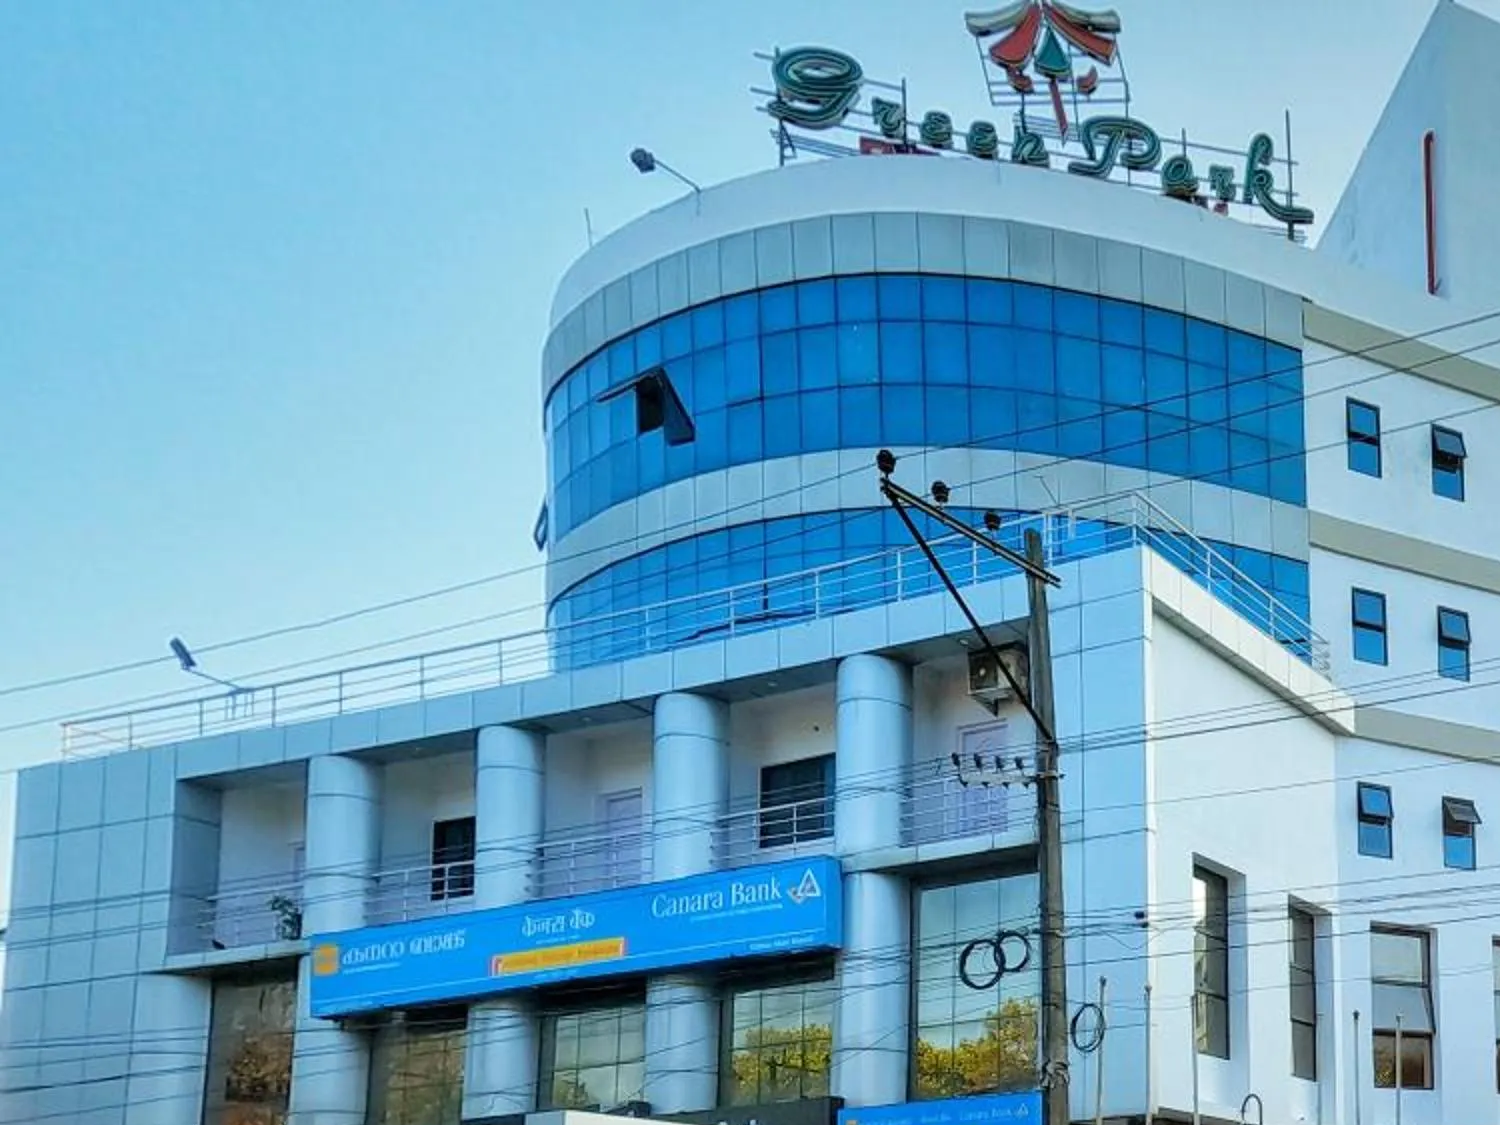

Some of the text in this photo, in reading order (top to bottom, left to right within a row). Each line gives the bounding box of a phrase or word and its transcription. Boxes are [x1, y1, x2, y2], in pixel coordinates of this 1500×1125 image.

[768, 46, 1314, 225] Green Park
[651, 891, 724, 918] Canara
[730, 874, 783, 907] Bank
